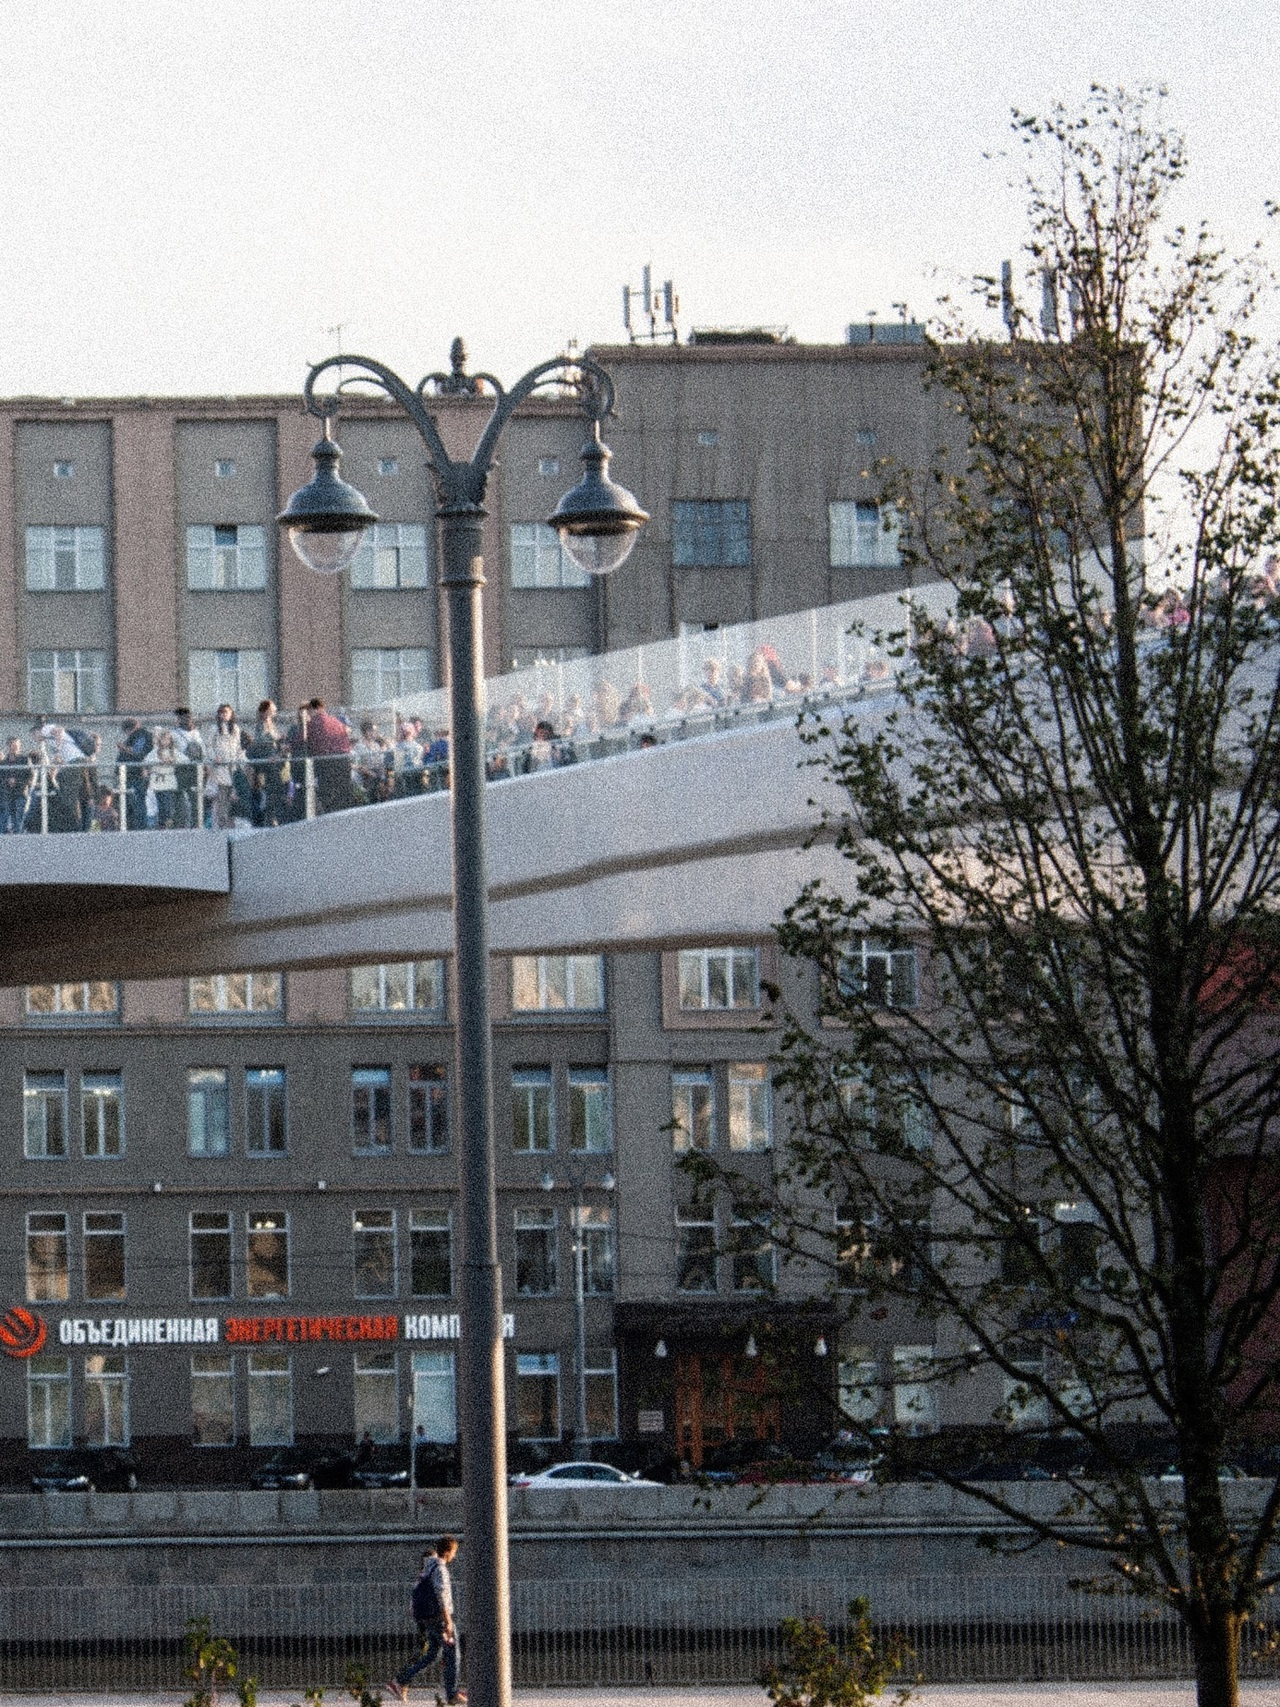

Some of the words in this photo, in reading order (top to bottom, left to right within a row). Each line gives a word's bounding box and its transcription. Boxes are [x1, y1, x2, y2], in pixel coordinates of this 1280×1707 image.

[59, 1317, 219, 1347] ОБЪЕДИНЕННАЯ
[225, 1315, 398, 1342] ЭНЕРГЕТИЧЕСКАЯ
[405, 1313, 516, 1339] КОМПЯ
